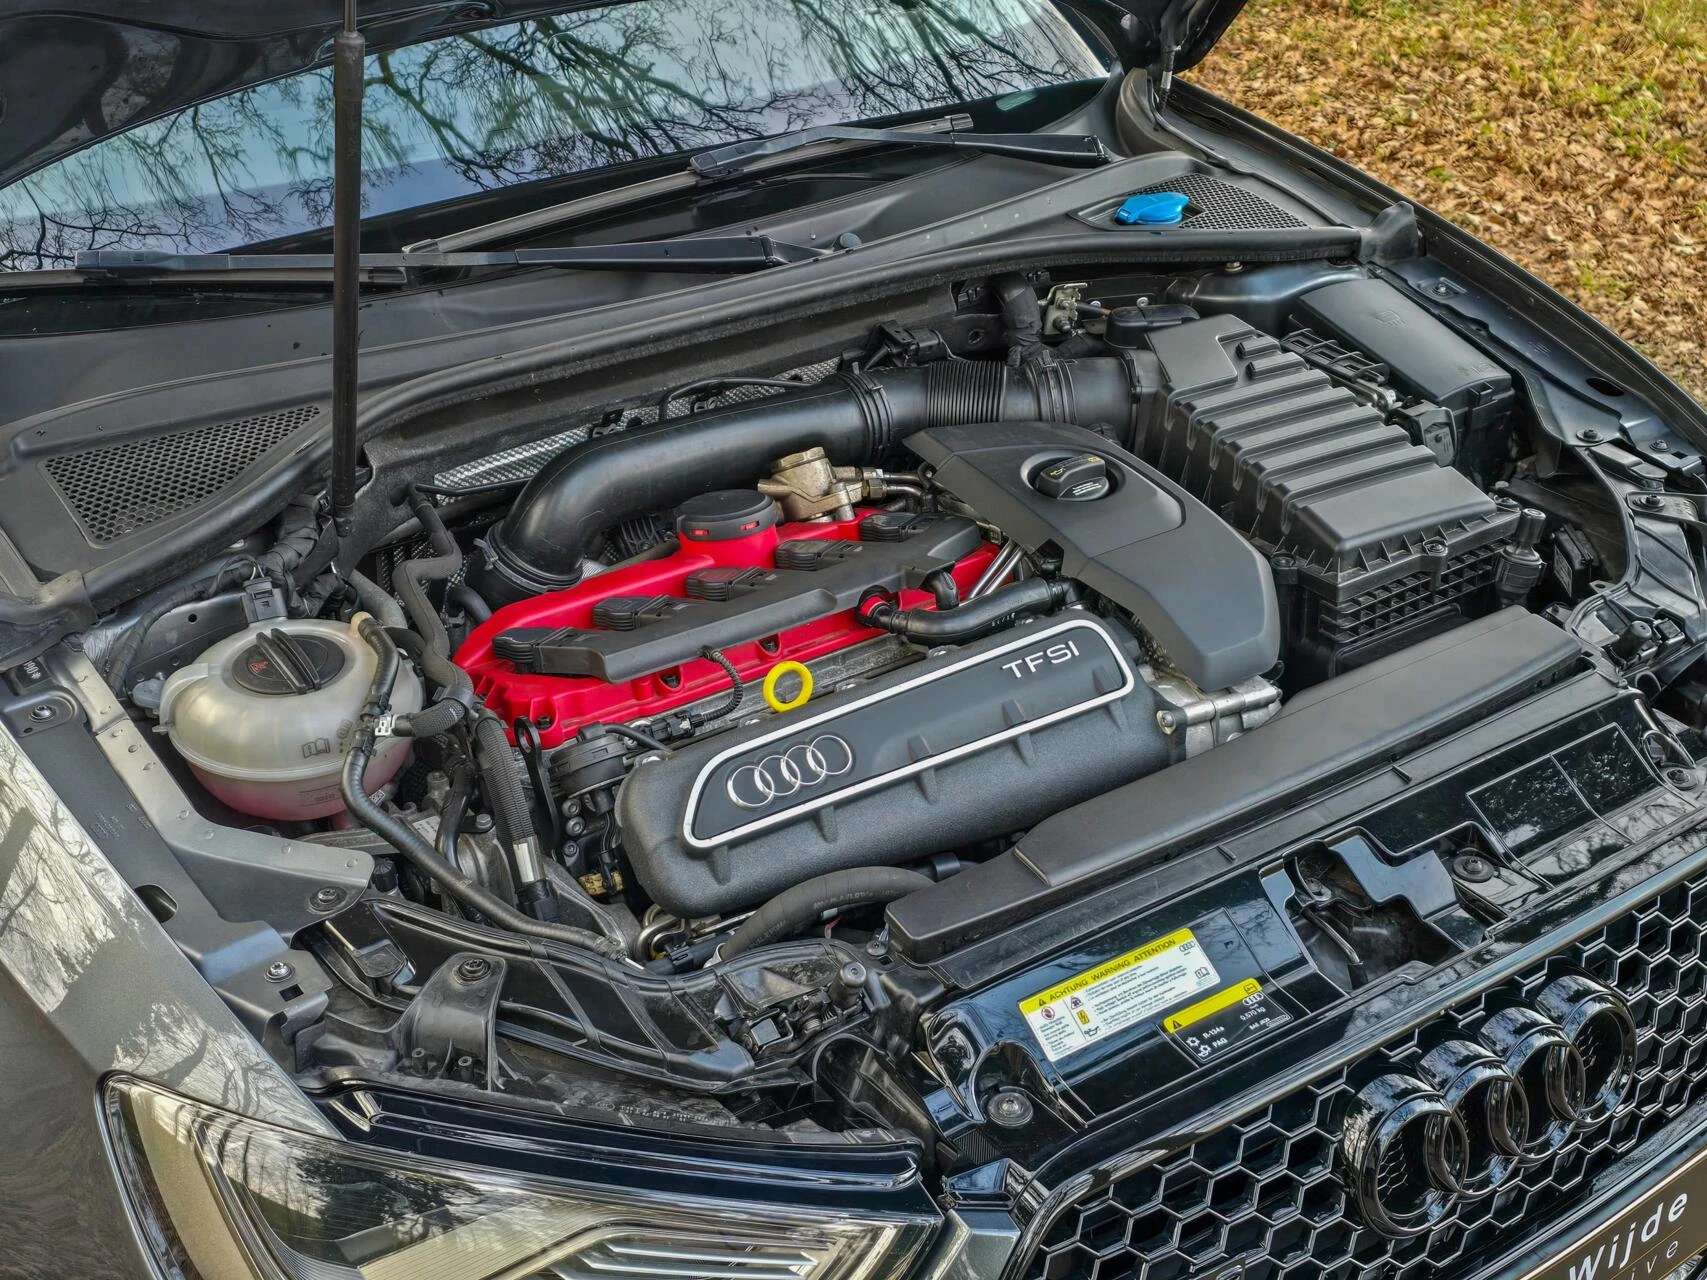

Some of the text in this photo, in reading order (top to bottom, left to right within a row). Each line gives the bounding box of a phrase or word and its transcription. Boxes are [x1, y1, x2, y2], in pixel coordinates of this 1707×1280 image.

[1002, 640, 1080, 678] TFSI
[1049, 980, 1089, 1001] ACHTUNG
[1091, 960, 1131, 981] WARNING
[1134, 938, 1177, 962] ATTENTION
[1569, 1193, 1688, 1280] Wijde
